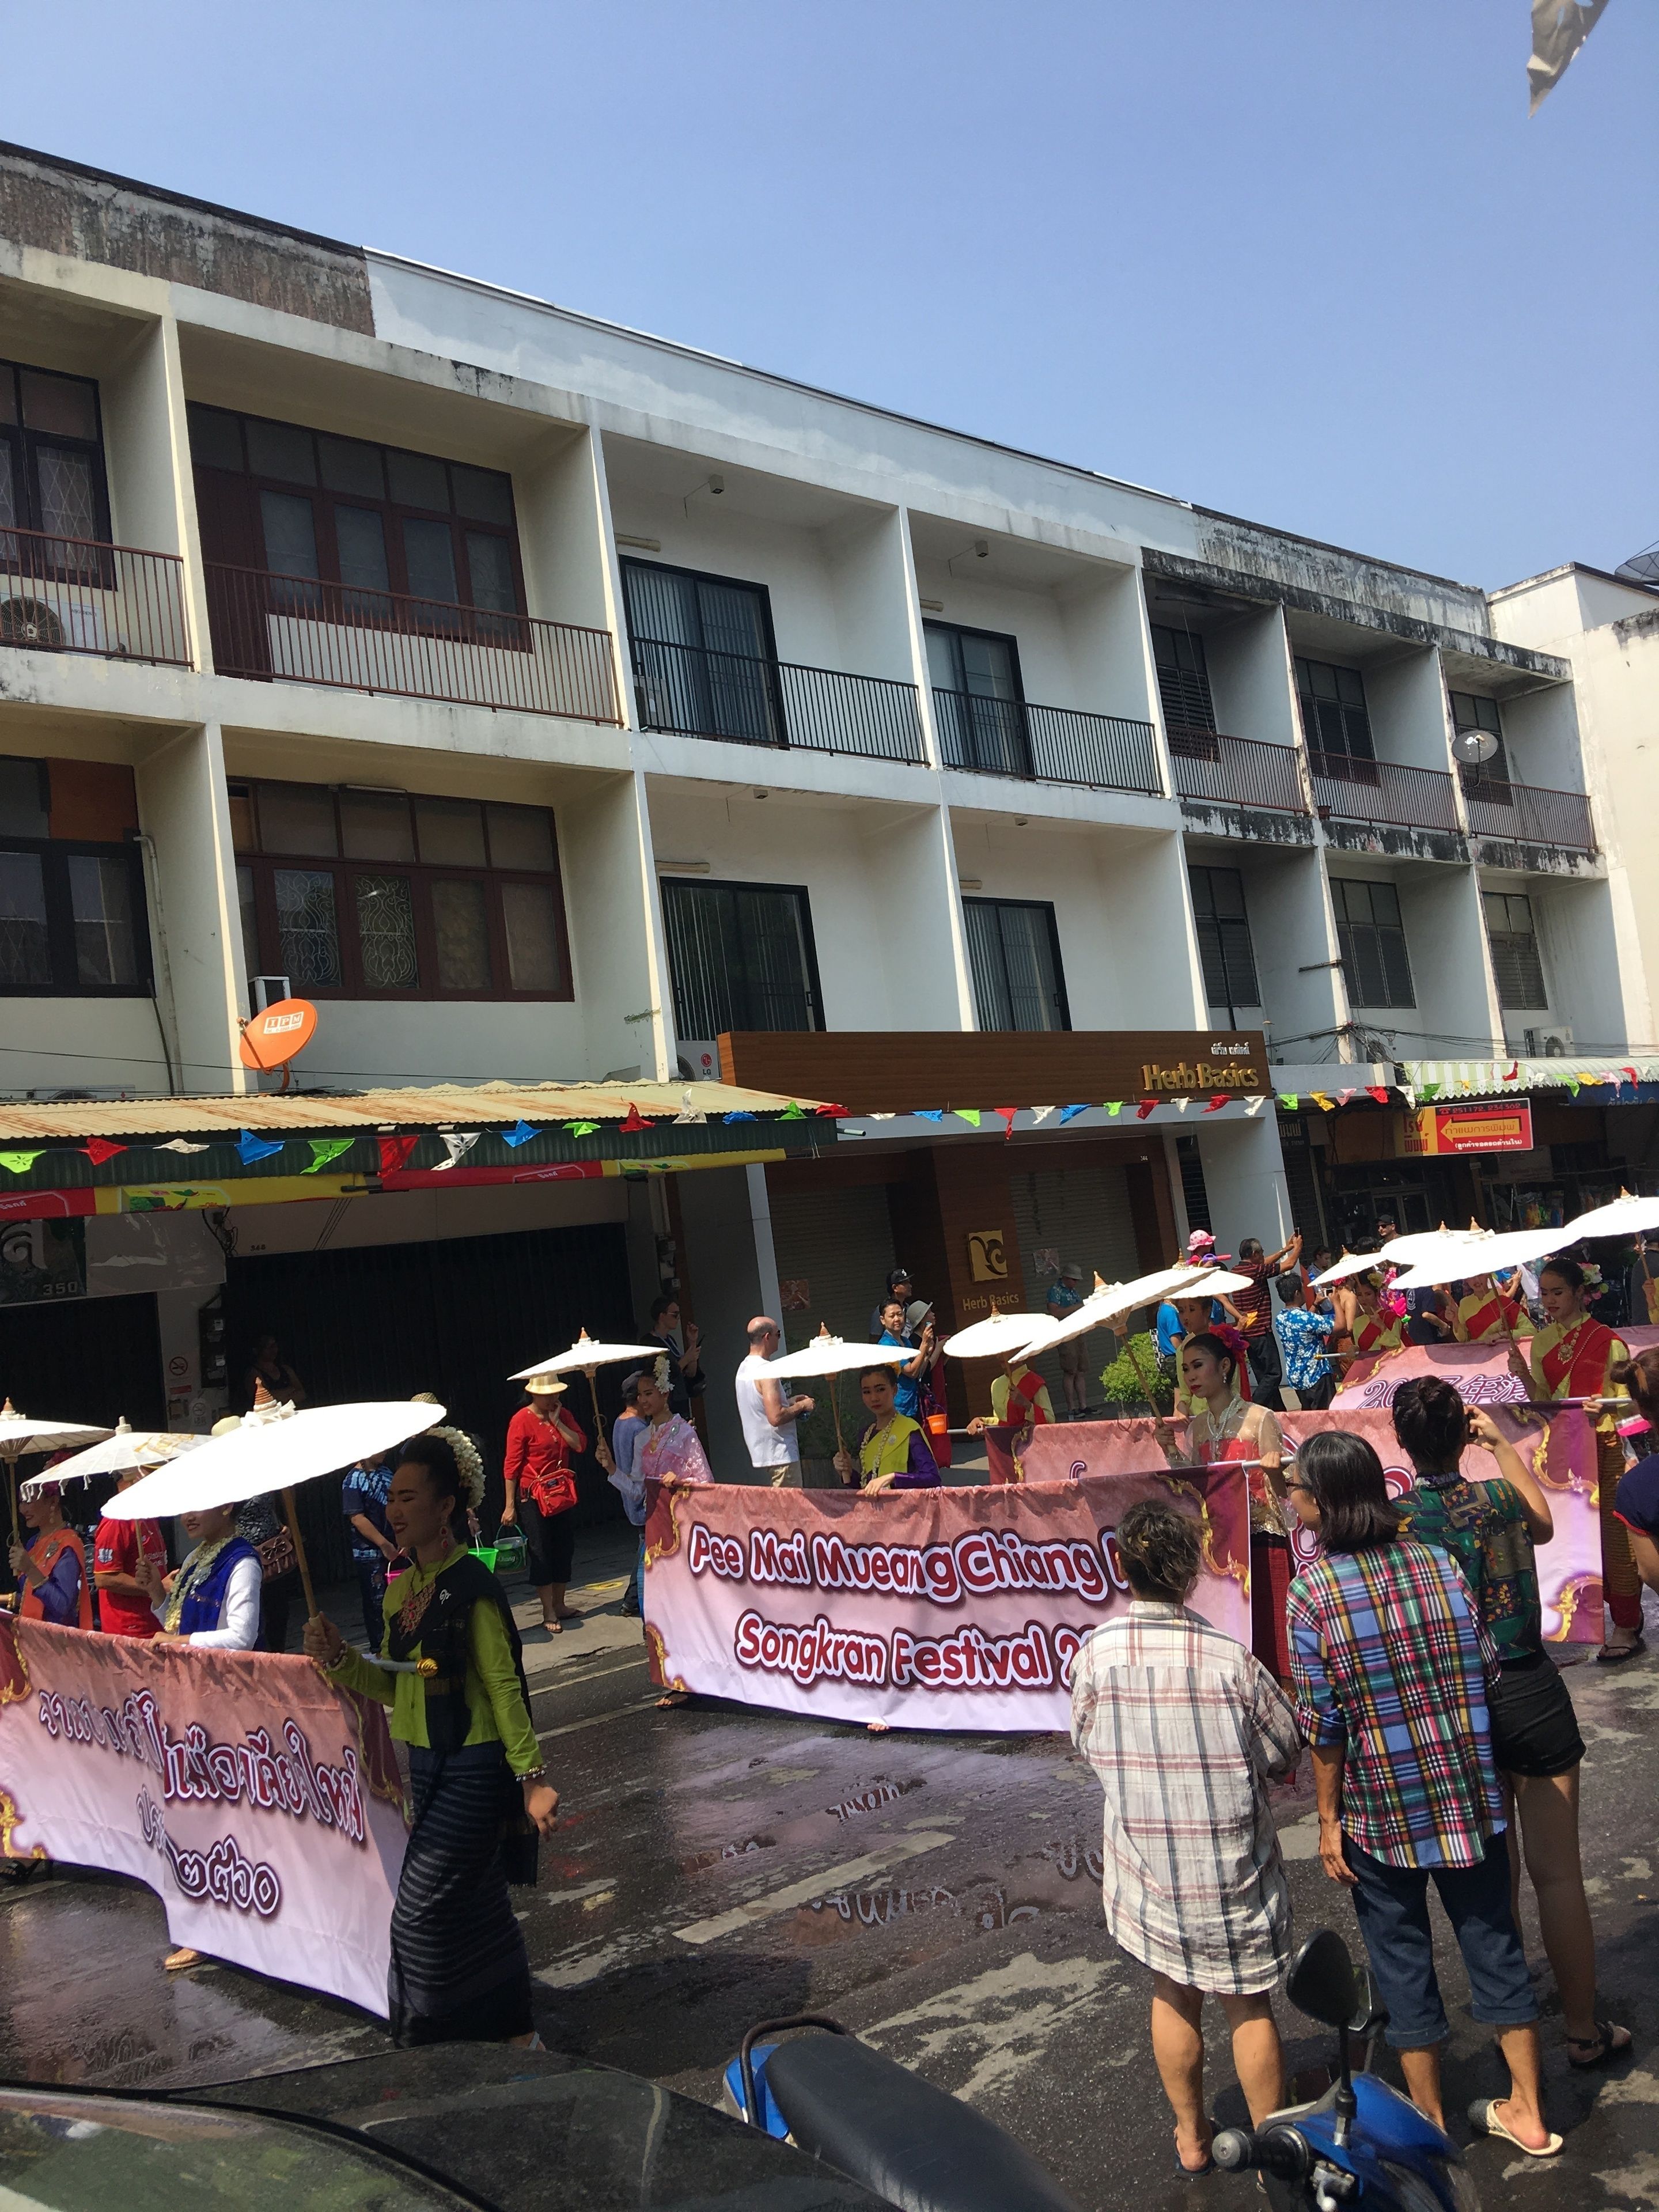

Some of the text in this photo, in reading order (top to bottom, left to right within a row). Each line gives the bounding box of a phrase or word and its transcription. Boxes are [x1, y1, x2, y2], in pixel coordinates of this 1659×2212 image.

[269, 1014, 301, 1028] IPM
[1142, 1062, 1259, 1090] Herb Basics
[1404, 1133, 1429, 1152] พิมพ์
[43, 1281, 78, 1296] 350
[962, 1291, 1019, 1311] Herb Basics
[690, 1524, 744, 1579] Pee
[751, 1530, 811, 1585] Mai
[812, 1536, 961, 1603] Mueang
[957, 1532, 1108, 1601] Chiang
[737, 1613, 888, 1685] Songkran
[892, 1625, 1053, 1685] Festival
[164, 1838, 280, 1915] ๒๕๖๐
